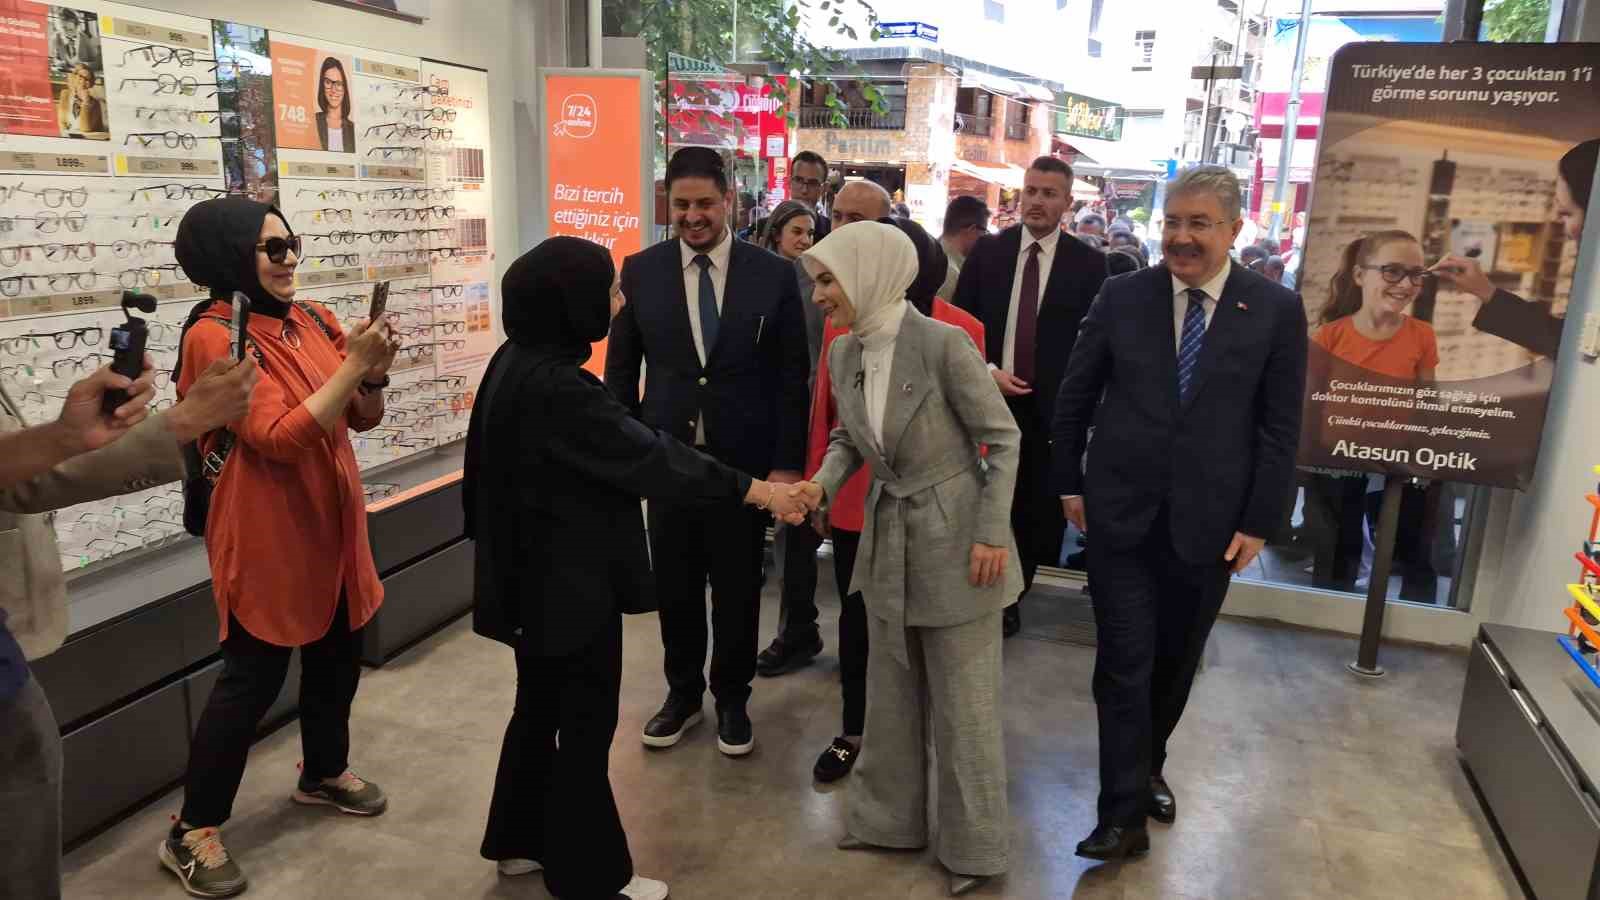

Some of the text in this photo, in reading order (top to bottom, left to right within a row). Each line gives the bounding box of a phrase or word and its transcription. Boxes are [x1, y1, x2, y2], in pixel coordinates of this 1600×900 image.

[1351, 64, 1593, 85] Türkiye'de her 3 çocuktan 1'i
[1372, 84, 1560, 106] görme sorunu yaşıyor.
[567, 104, 592, 117] 7/24
[554, 183, 624, 204] Bizi tercih
[554, 208, 639, 232] ettiğiniz için
[1330, 379, 1415, 395] Çocuklarımızın
[1416, 387, 1437, 399] göz
[1479, 392, 1501, 405] için
[1311, 391, 1516, 419] doktor kontrolünü ihmal etmeyelim.
[1327, 415, 1362, 426] Çünkü
[1331, 439, 1478, 471] Atasun Optik
